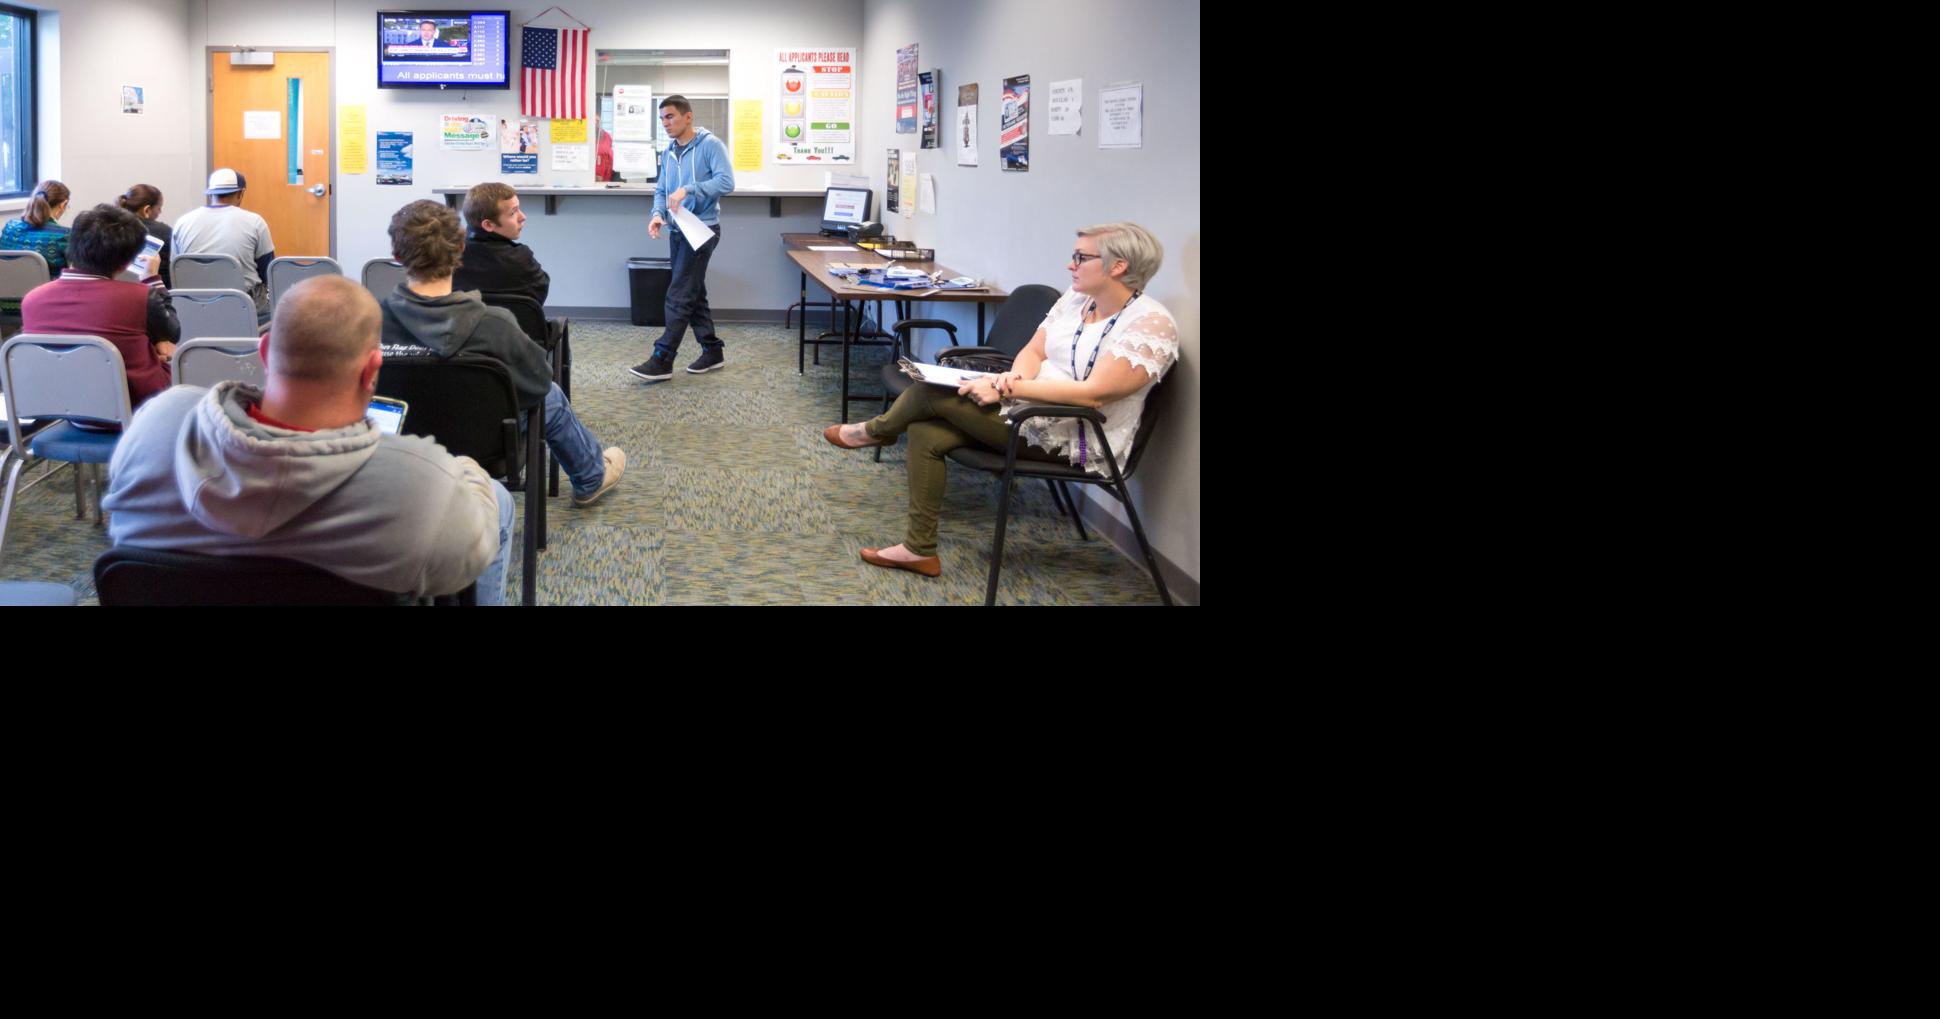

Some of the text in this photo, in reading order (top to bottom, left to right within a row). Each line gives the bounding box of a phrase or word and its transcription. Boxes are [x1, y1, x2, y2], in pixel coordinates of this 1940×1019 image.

[779, 52, 849, 63] ALL APPLICANTS PLEASE READ
[413, 72, 465, 82] applicants
[444, 132, 480, 141] Message
